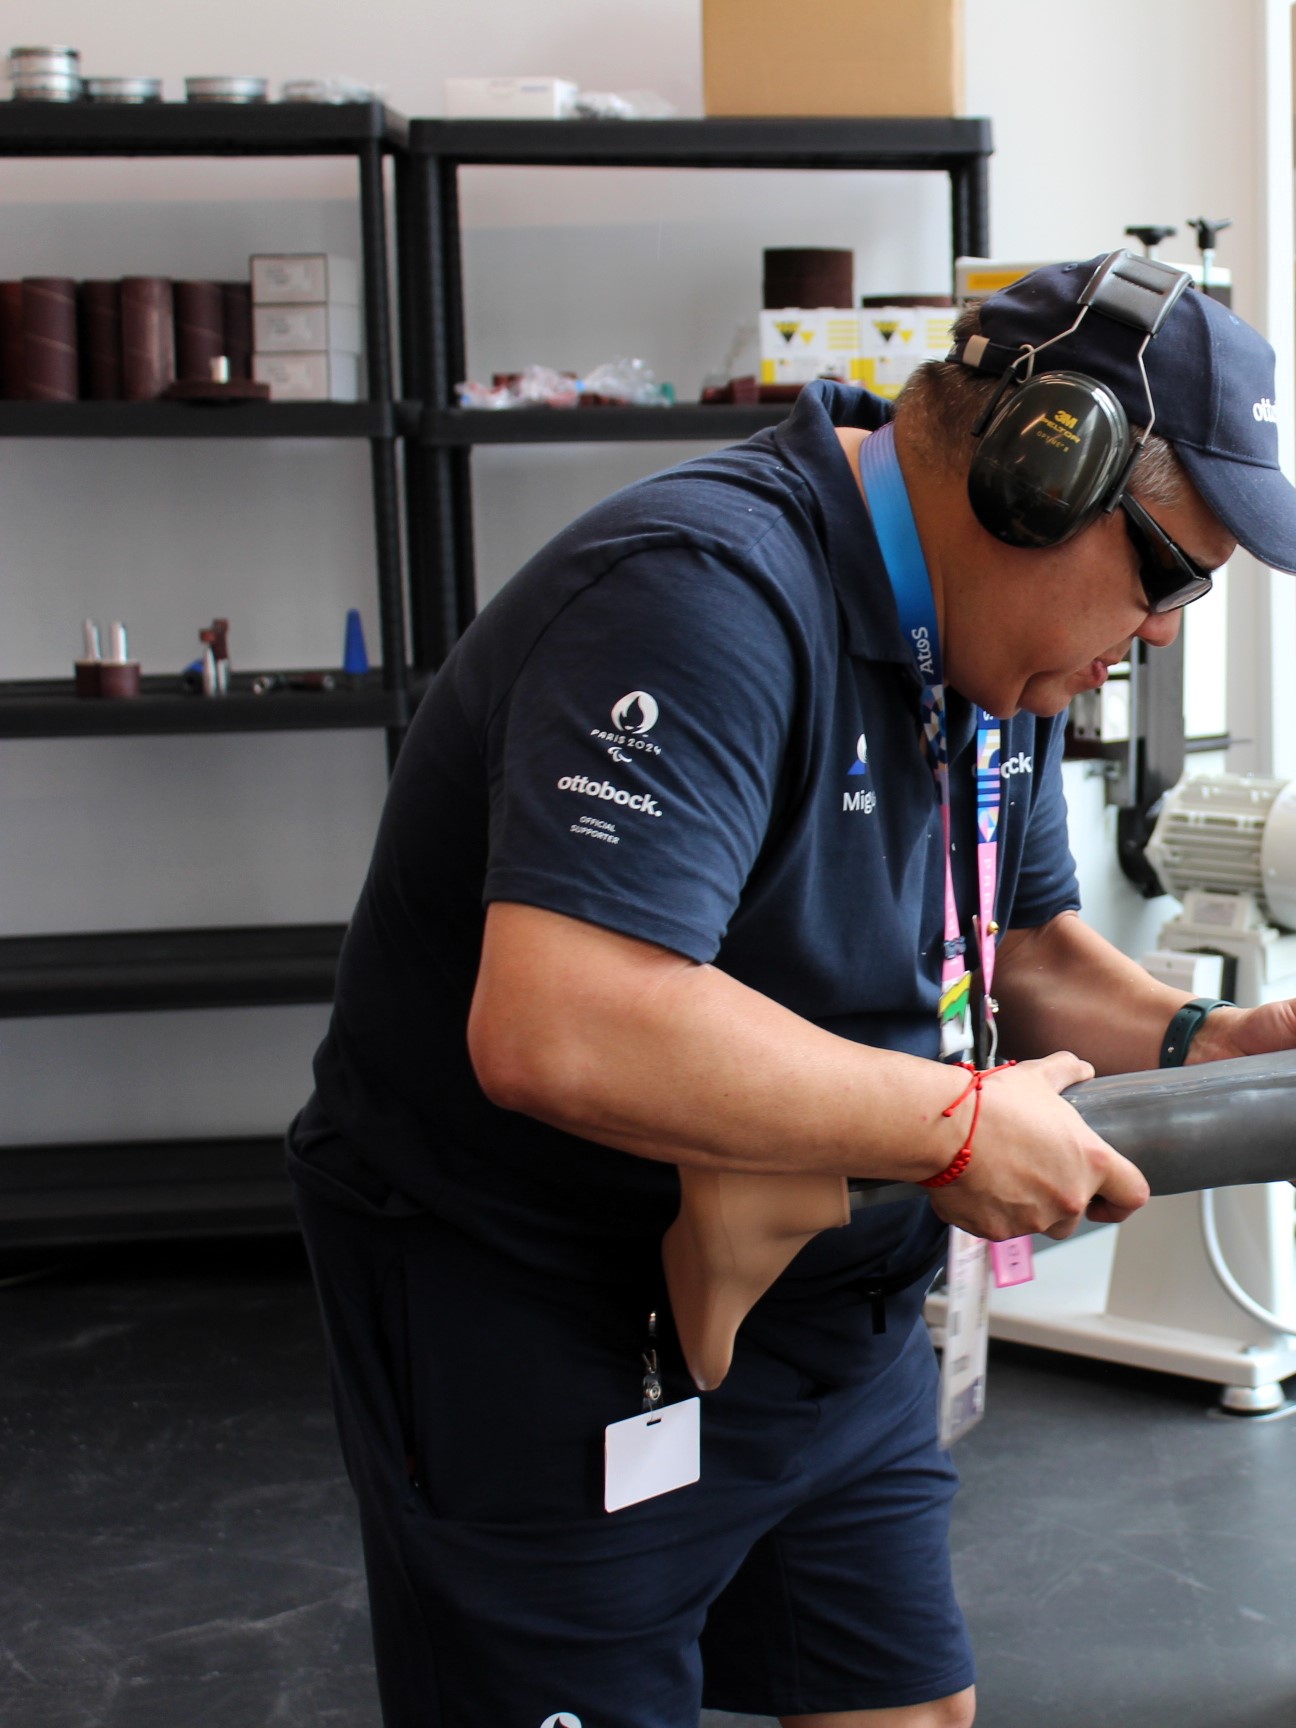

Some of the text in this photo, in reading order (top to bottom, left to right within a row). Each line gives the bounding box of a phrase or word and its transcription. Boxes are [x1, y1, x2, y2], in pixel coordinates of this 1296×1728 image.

[1054, 409, 1079, 430] 3M
[911, 626, 934, 675] Atos
[590, 728, 662, 755] PARIS 2024
[579, 815, 617, 832] OFFICIAL
[570, 824, 620, 845] SUPPORTER
